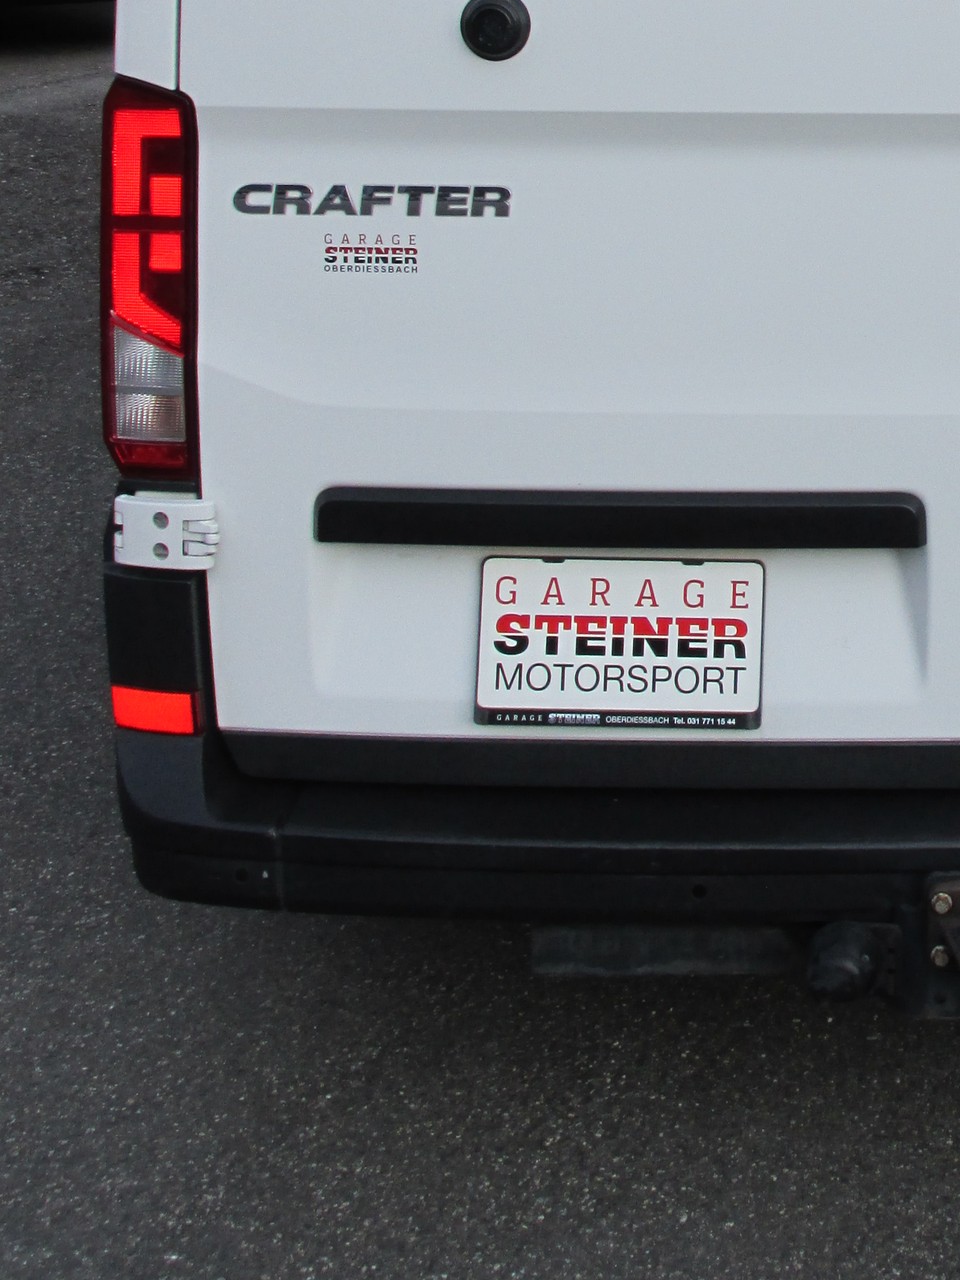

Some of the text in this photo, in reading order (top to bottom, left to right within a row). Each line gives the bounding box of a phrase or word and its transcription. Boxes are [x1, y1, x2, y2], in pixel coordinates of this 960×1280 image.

[233, 183, 512, 217] CRAFTER
[323, 233, 417, 245] GARAGE
[323, 246, 418, 264] STEINER
[323, 264, 418, 274] OBERDIESSBACH
[495, 576, 749, 609] GARAGE
[493, 613, 748, 659] STEINER
[494, 662, 747, 695] MOTORSPORT
[496, 713, 736, 726] GARAGE STEINER OBERDIESSBACH Tel. 031 771 15 44
